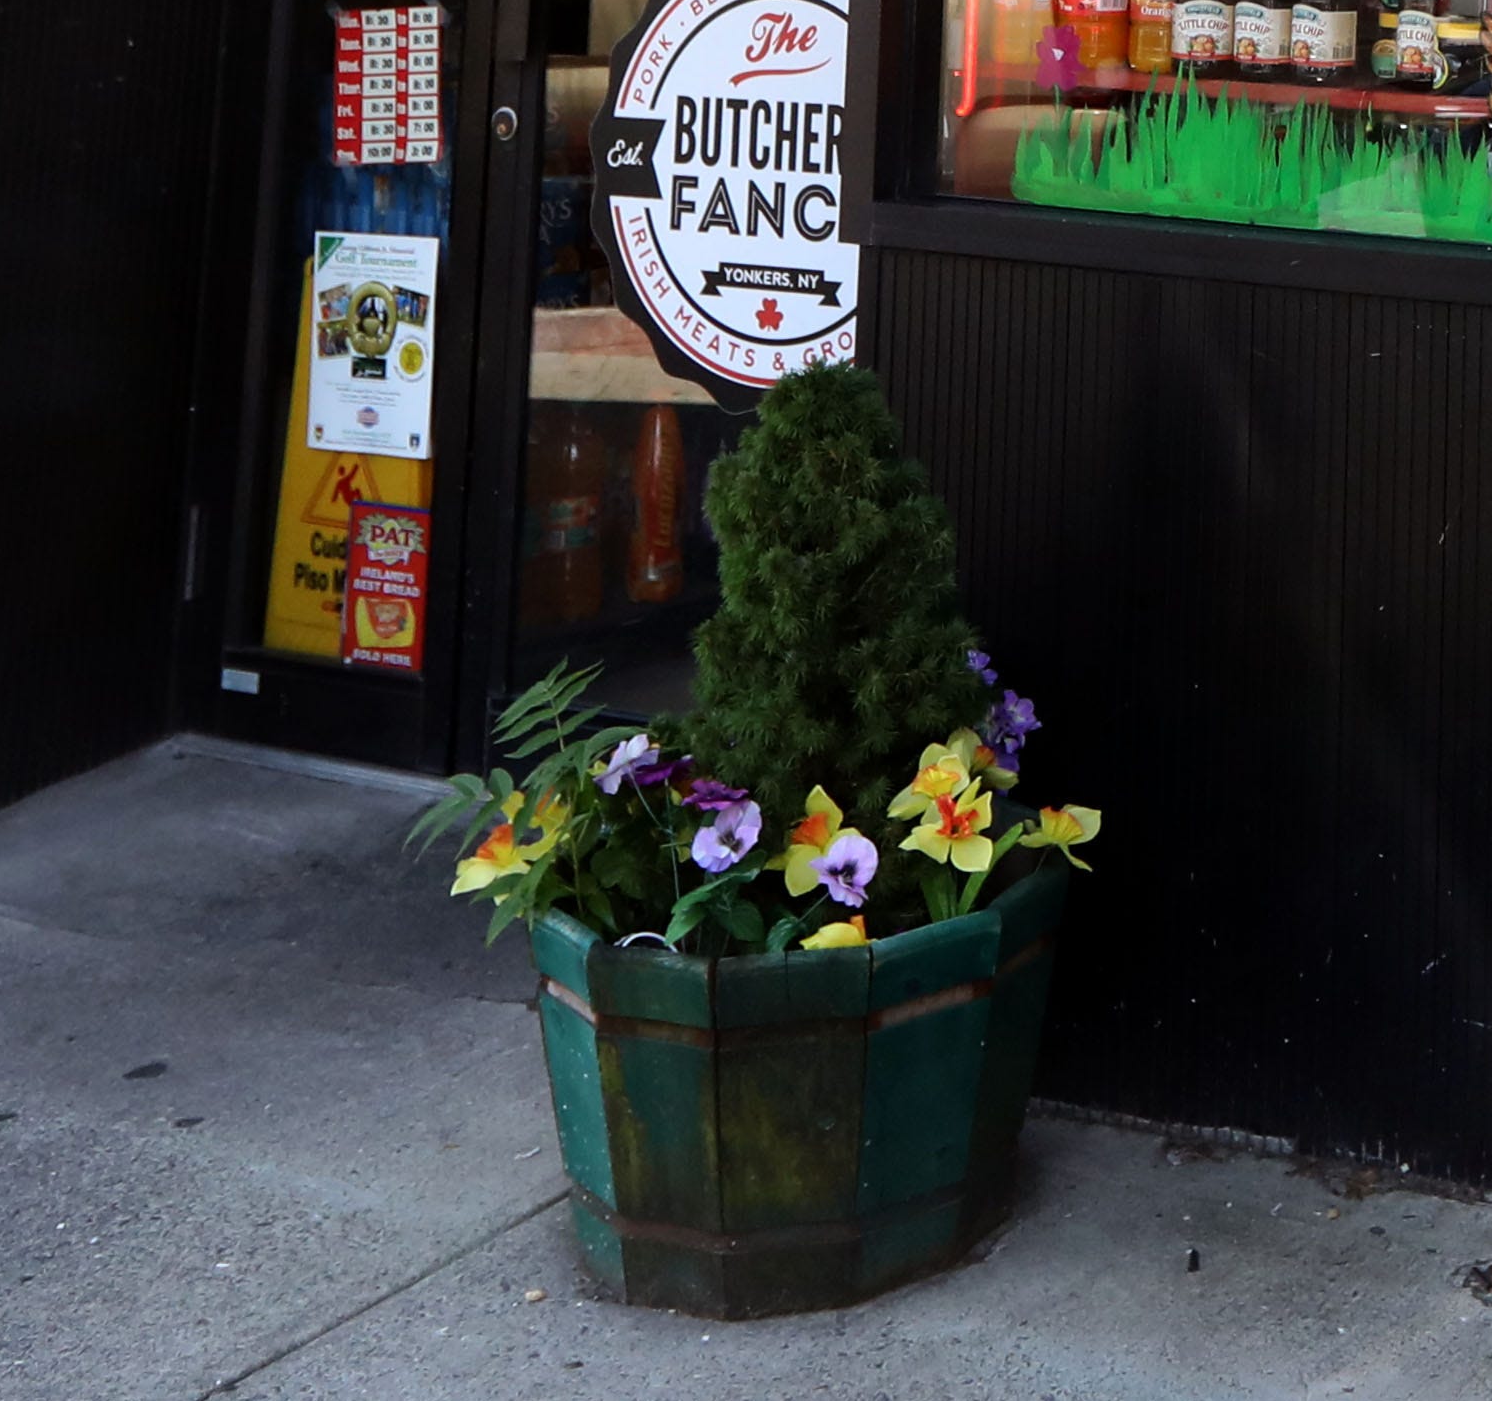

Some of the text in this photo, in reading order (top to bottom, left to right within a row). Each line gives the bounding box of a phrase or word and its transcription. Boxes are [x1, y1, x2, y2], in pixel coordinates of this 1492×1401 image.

[745, 12, 818, 64] The
[634, 33, 674, 104] PORK
[607, 139, 643, 168] Est.
[629, 216, 670, 299] IRISH
[674, 305, 755, 368] MEATS
[773, 352, 784, 372] &
[724, 266, 820, 290] YONKERS, NY
[370, 525, 415, 546] PAT
